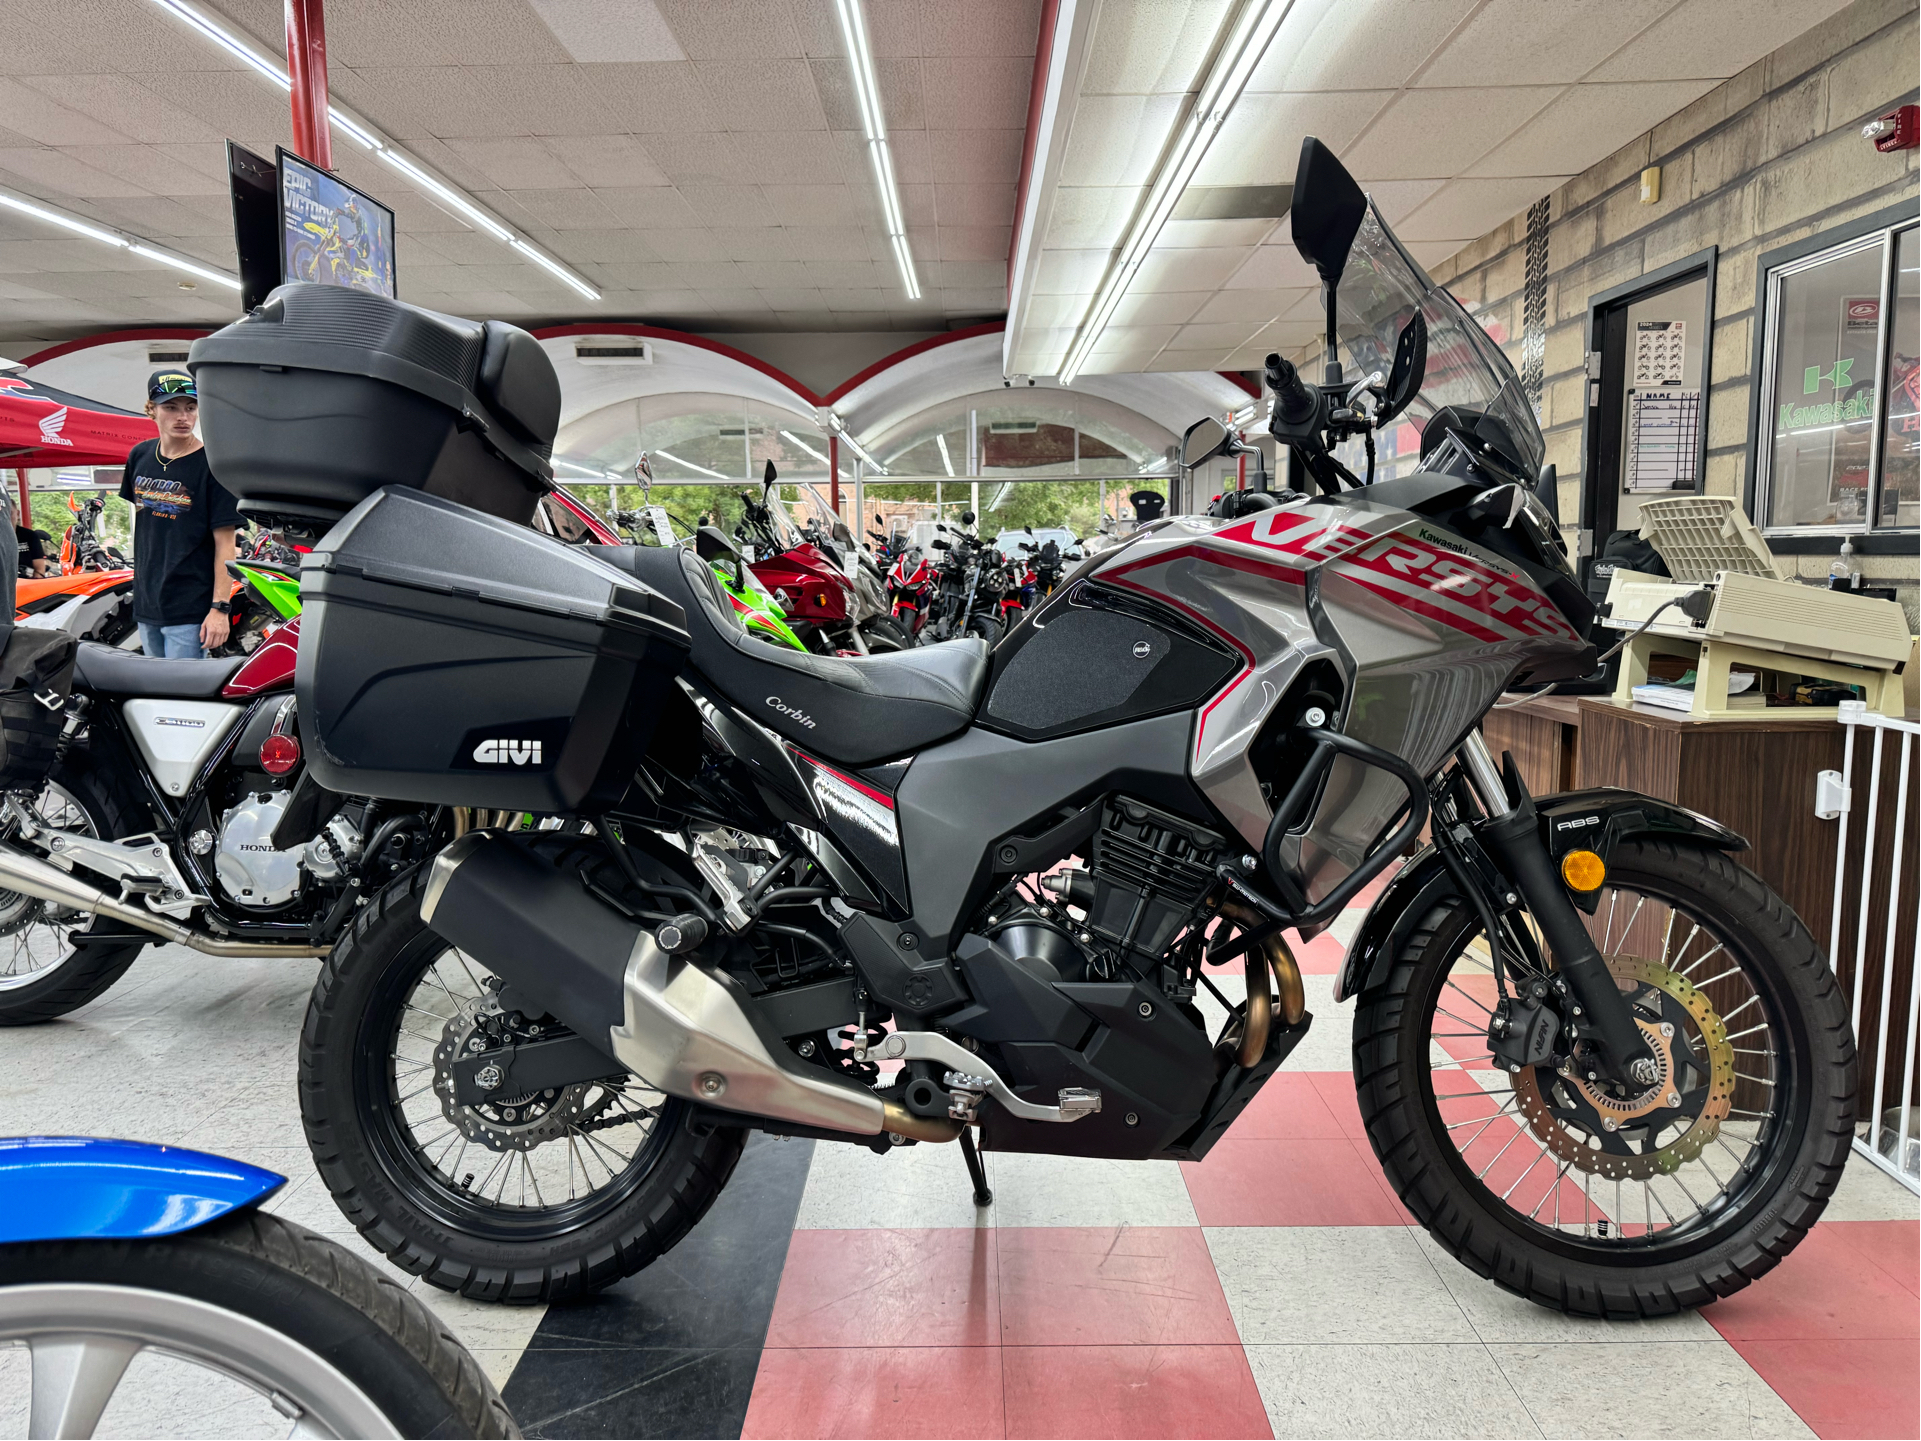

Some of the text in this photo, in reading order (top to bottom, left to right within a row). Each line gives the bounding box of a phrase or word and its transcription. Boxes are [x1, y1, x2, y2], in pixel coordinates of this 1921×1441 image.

[283, 166, 312, 197] EPIC
[284, 187, 334, 225] VICTORY
[1779, 389, 1875, 430] Kawasaki
[40, 435, 74, 447] HONDA
[90, 430, 119, 438] MATRIX
[1419, 528, 1469, 555] Kawasaki
[1251, 511, 1571, 638] VERSYS
[765, 696, 817, 729] Corbin
[472, 739, 542, 766] GIVI
[1557, 815, 1600, 832] ABS
[240, 844, 288, 853] HOND
